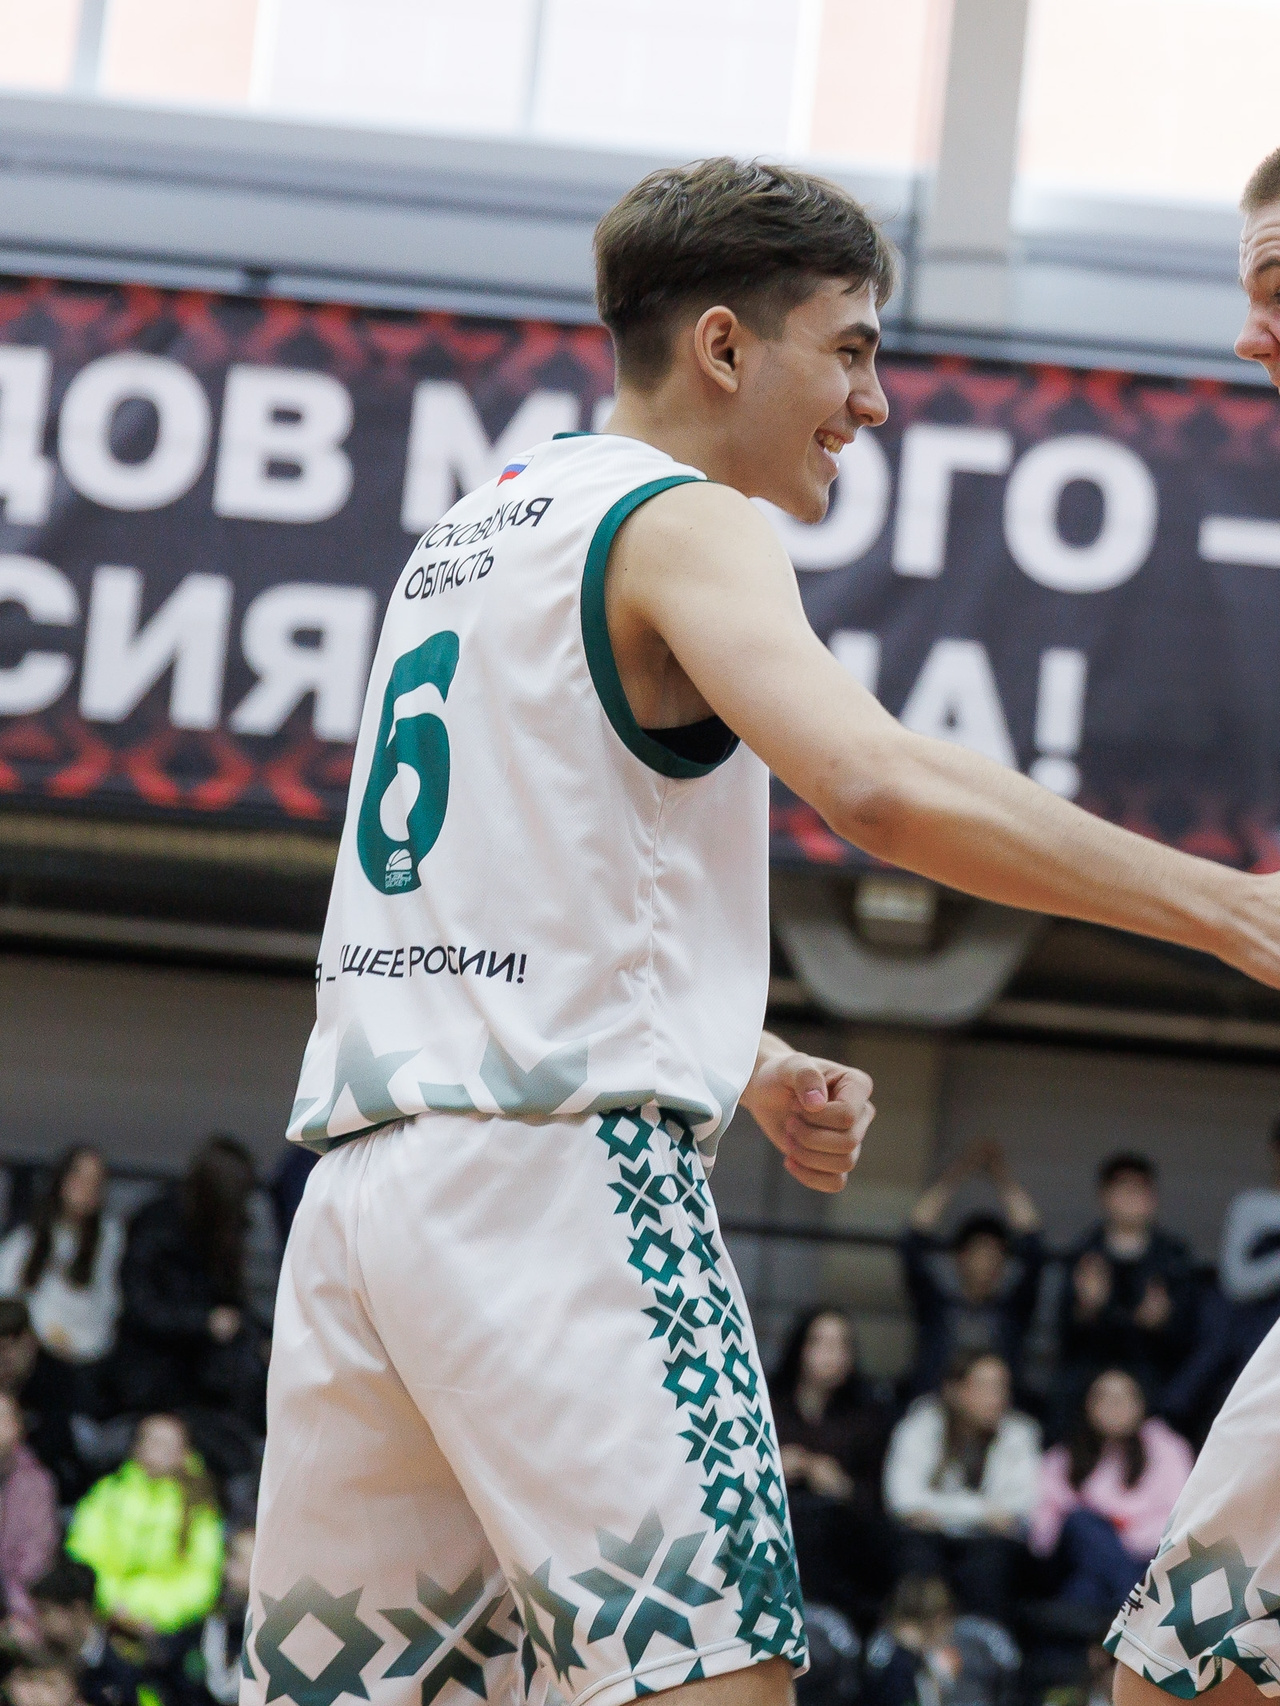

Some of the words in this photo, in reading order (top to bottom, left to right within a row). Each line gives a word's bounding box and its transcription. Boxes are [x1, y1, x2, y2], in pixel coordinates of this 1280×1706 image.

[400, 380, 1158, 594] МОГО
[417, 497, 554, 550] СКОВСКАЯ
[404, 546, 495, 600] ОБЛАСТЬ
[357, 630, 460, 895] 6
